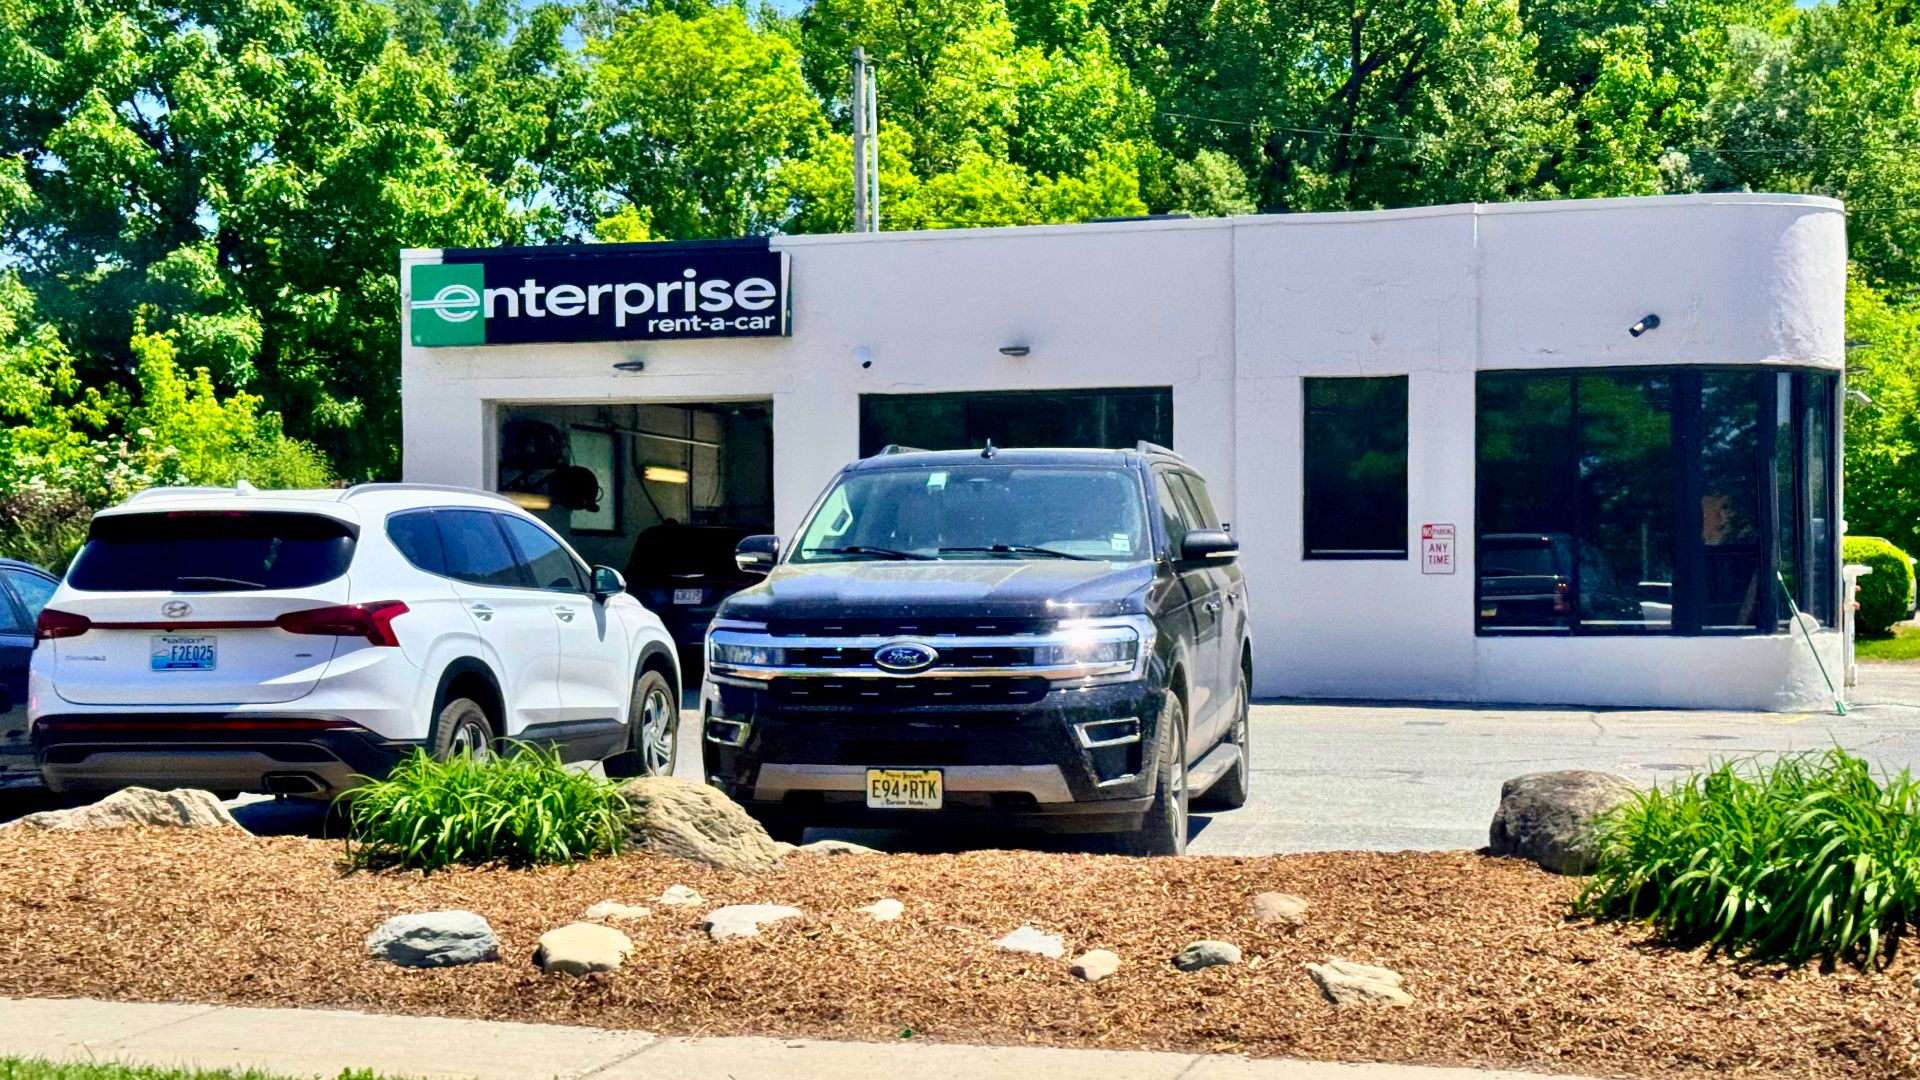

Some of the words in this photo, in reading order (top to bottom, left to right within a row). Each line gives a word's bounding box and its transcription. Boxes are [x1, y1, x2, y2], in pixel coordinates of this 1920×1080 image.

[432, 268, 777, 328] enterprise
[648, 313, 775, 333] rent-a-car
[1423, 527, 1433, 535] NO
[1429, 543, 1448, 552] ANY
[1428, 555, 1450, 565] TIME
[888, 649, 920, 664] Ford
